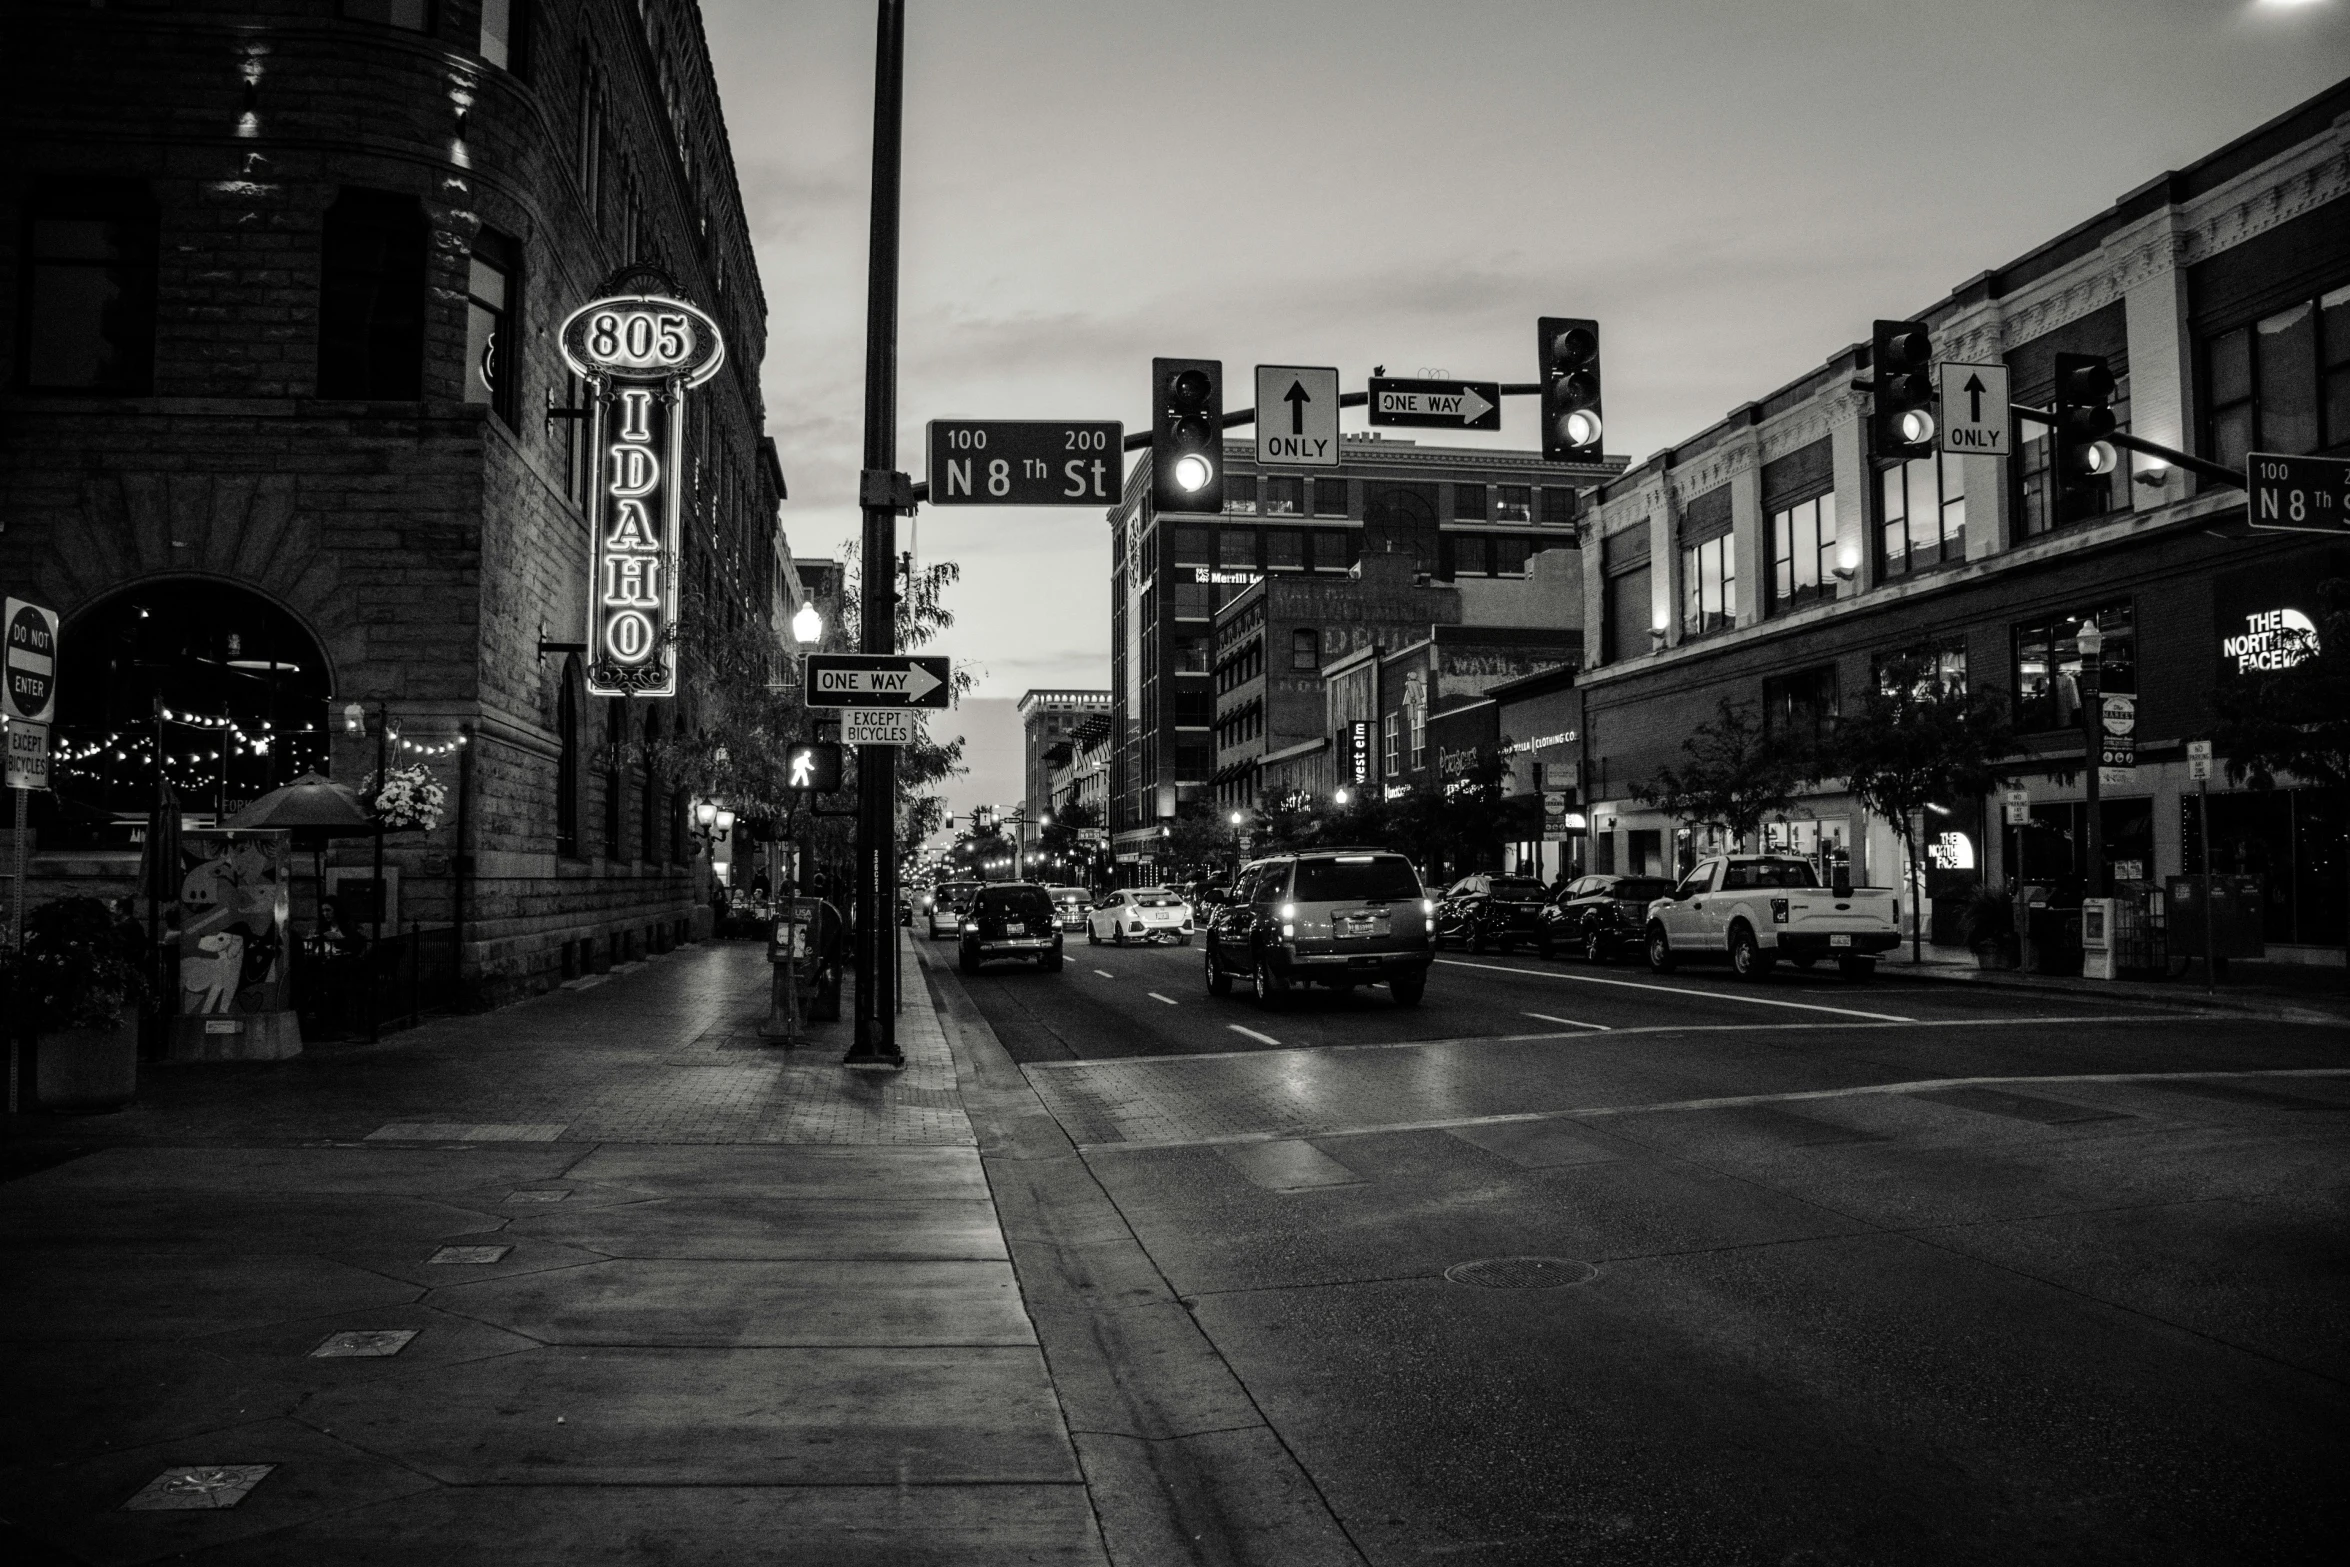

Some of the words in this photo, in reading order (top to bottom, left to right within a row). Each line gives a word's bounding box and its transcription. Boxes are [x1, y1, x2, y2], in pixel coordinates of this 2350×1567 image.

[590, 313, 687, 362] 805
[1383, 395, 1417, 411] ONE
[1429, 397, 1463, 413] WAY
[948, 430, 987, 449] 100
[1065, 431, 1106, 450] 200
[1269, 438, 1327, 457] ONLY
[1952, 428, 2000, 448] ONLY
[947, 458, 972, 496] N
[1064, 459, 1106, 497] St
[2260, 462, 2288, 481] 100
[2261, 487, 2279, 520] N
[604, 391, 660, 662] IDAHO
[1211, 573, 1247, 584] Merrill
[2246, 610, 2282, 634] THE
[14, 623, 27, 643] DO
[31, 629, 50, 650] NOT
[15, 675, 44, 698] ENTER
[822, 672, 859, 690] ONE
[871, 674, 908, 690] WAY
[854, 711, 902, 725] EXCEPT
[13, 732, 42, 752] EXCEPT
[848, 727, 907, 741] BICYCLES
[1353, 723, 1366, 749] elm
[1535, 734, 1565, 749] CLOTHING
[8, 755, 46, 775] BICYCLES
[1353, 751, 1366, 784] west
[1940, 832, 1958, 844] THE
[1928, 844, 1958, 857] NORTH
